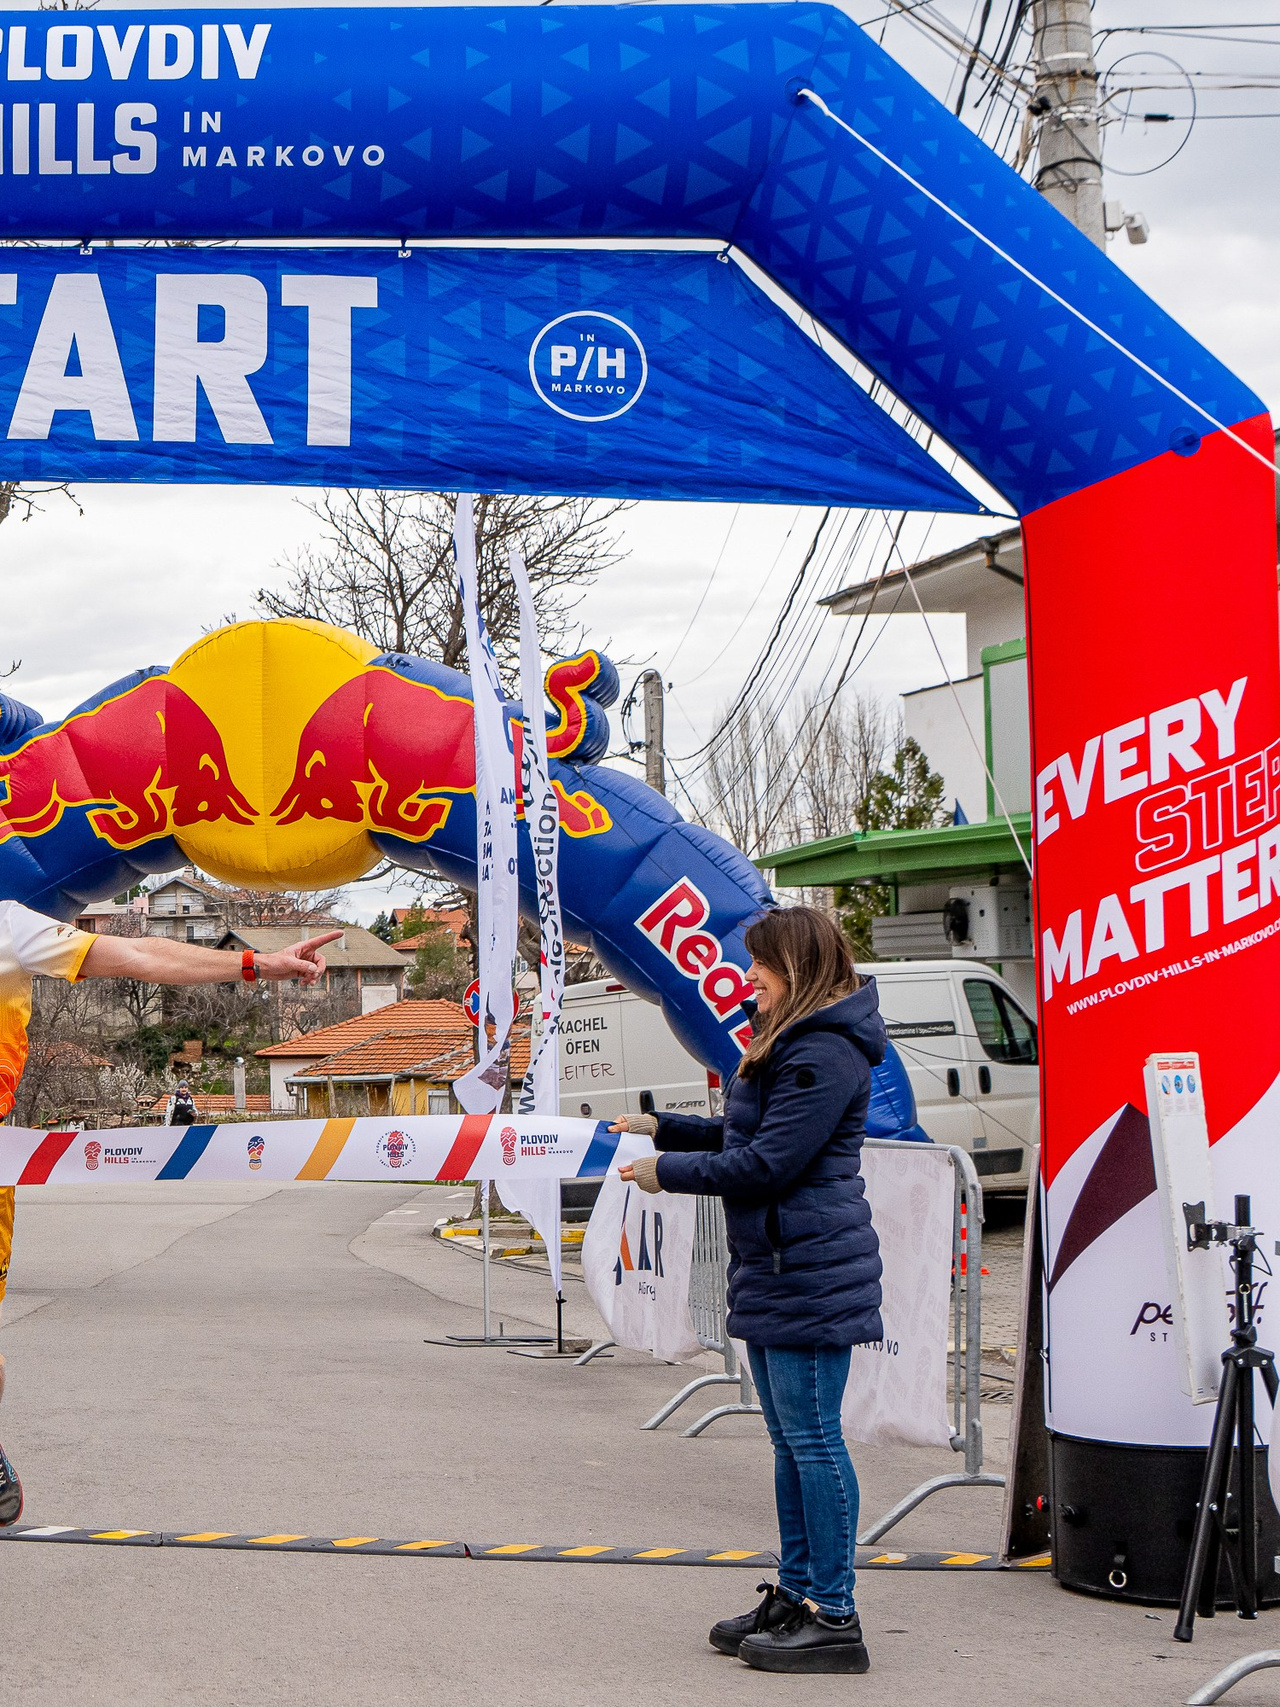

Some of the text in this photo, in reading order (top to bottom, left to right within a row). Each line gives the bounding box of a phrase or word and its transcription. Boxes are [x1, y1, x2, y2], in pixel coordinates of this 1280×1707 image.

[183, 111, 222, 133] IN
[182, 145, 386, 168] MARKOVO
[579, 333, 595, 342] IN
[551, 345, 626, 380] P/H
[551, 383, 626, 395] MARKOVO
[1036, 676, 1248, 846] EVERY
[557, 1016, 608, 1035] KACHEL
[565, 1038, 600, 1055] ÖFEN
[559, 1062, 616, 1081] EITER
[520, 1134, 559, 1145] PLOVDIV
[104, 1147, 143, 1156] PLOVDIV
[521, 1146, 546, 1156] HILLS
[104, 1156, 129, 1164] HILLS
